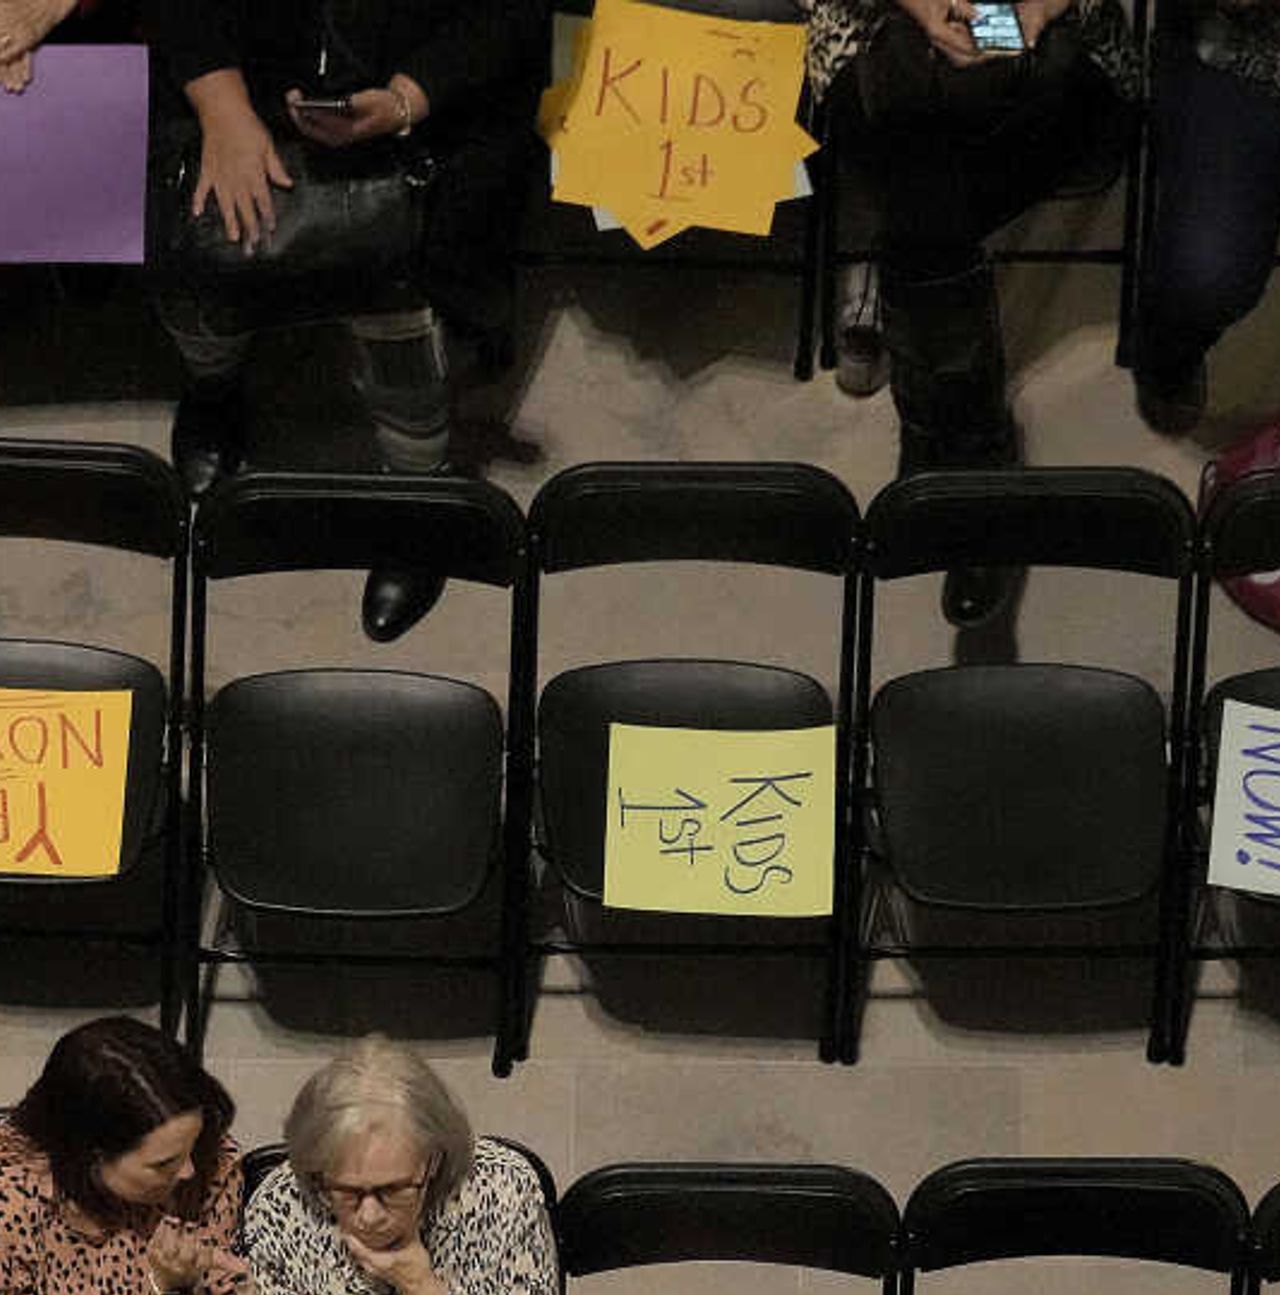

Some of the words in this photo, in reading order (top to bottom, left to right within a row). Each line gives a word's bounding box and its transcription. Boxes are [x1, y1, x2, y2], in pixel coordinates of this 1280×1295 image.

[596, 48, 767, 134] KIDS
[648, 139, 713, 201] 1st
[619, 786, 713, 865] 1st
[720, 771, 813, 896] KIDS
